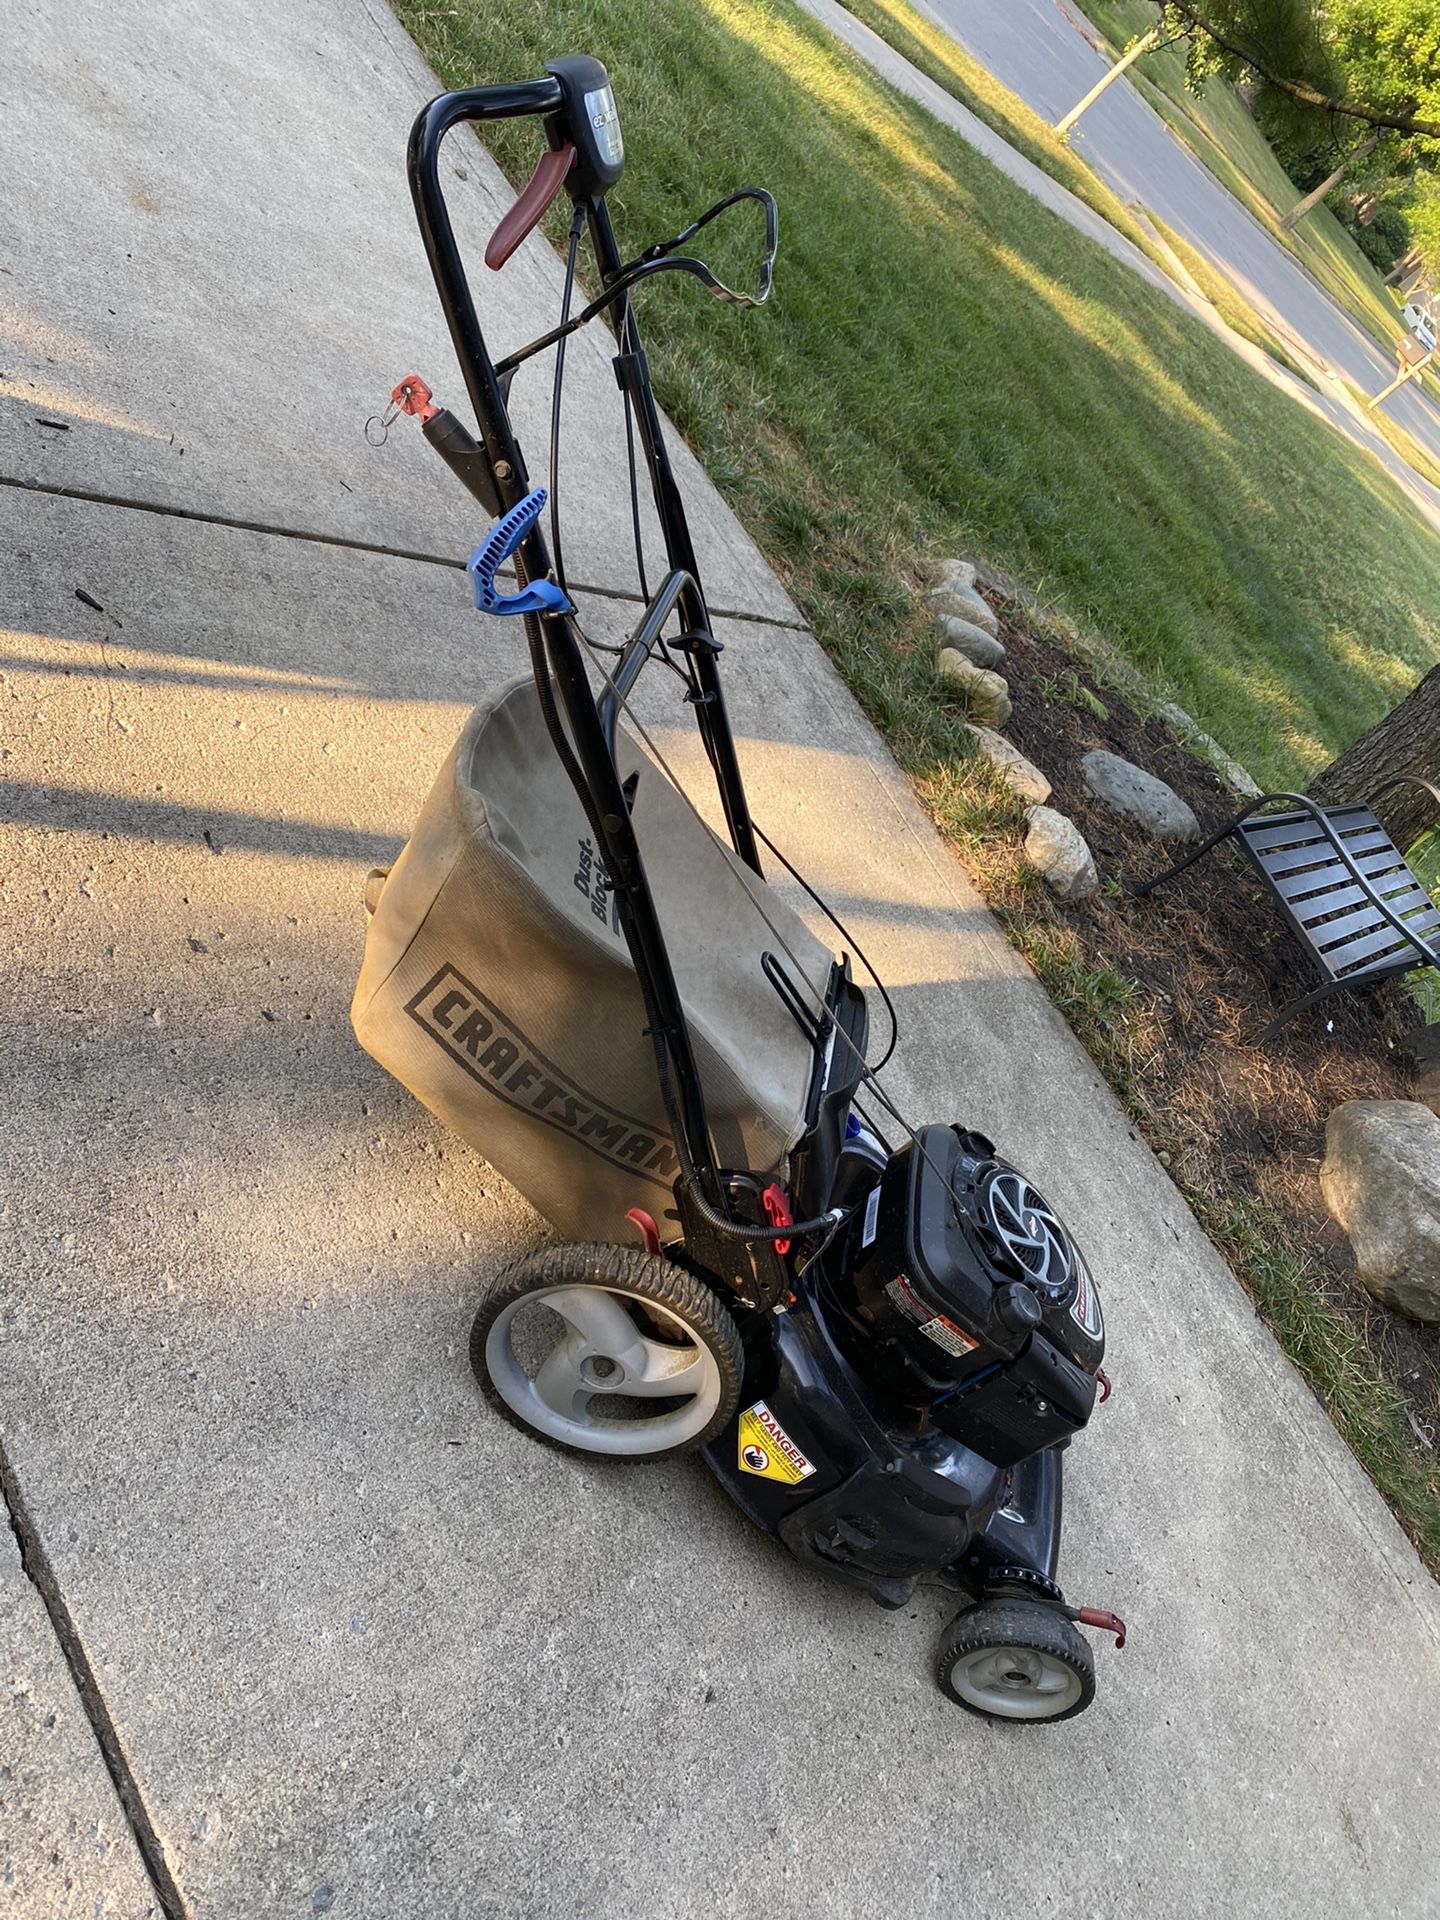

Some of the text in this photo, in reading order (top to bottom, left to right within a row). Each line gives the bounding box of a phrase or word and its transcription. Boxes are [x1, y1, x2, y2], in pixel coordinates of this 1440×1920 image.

[574, 838, 593, 899] Dust-
[432, 989, 682, 1177] CRAFTSMAN
[758, 1411, 806, 1469] DANGER
